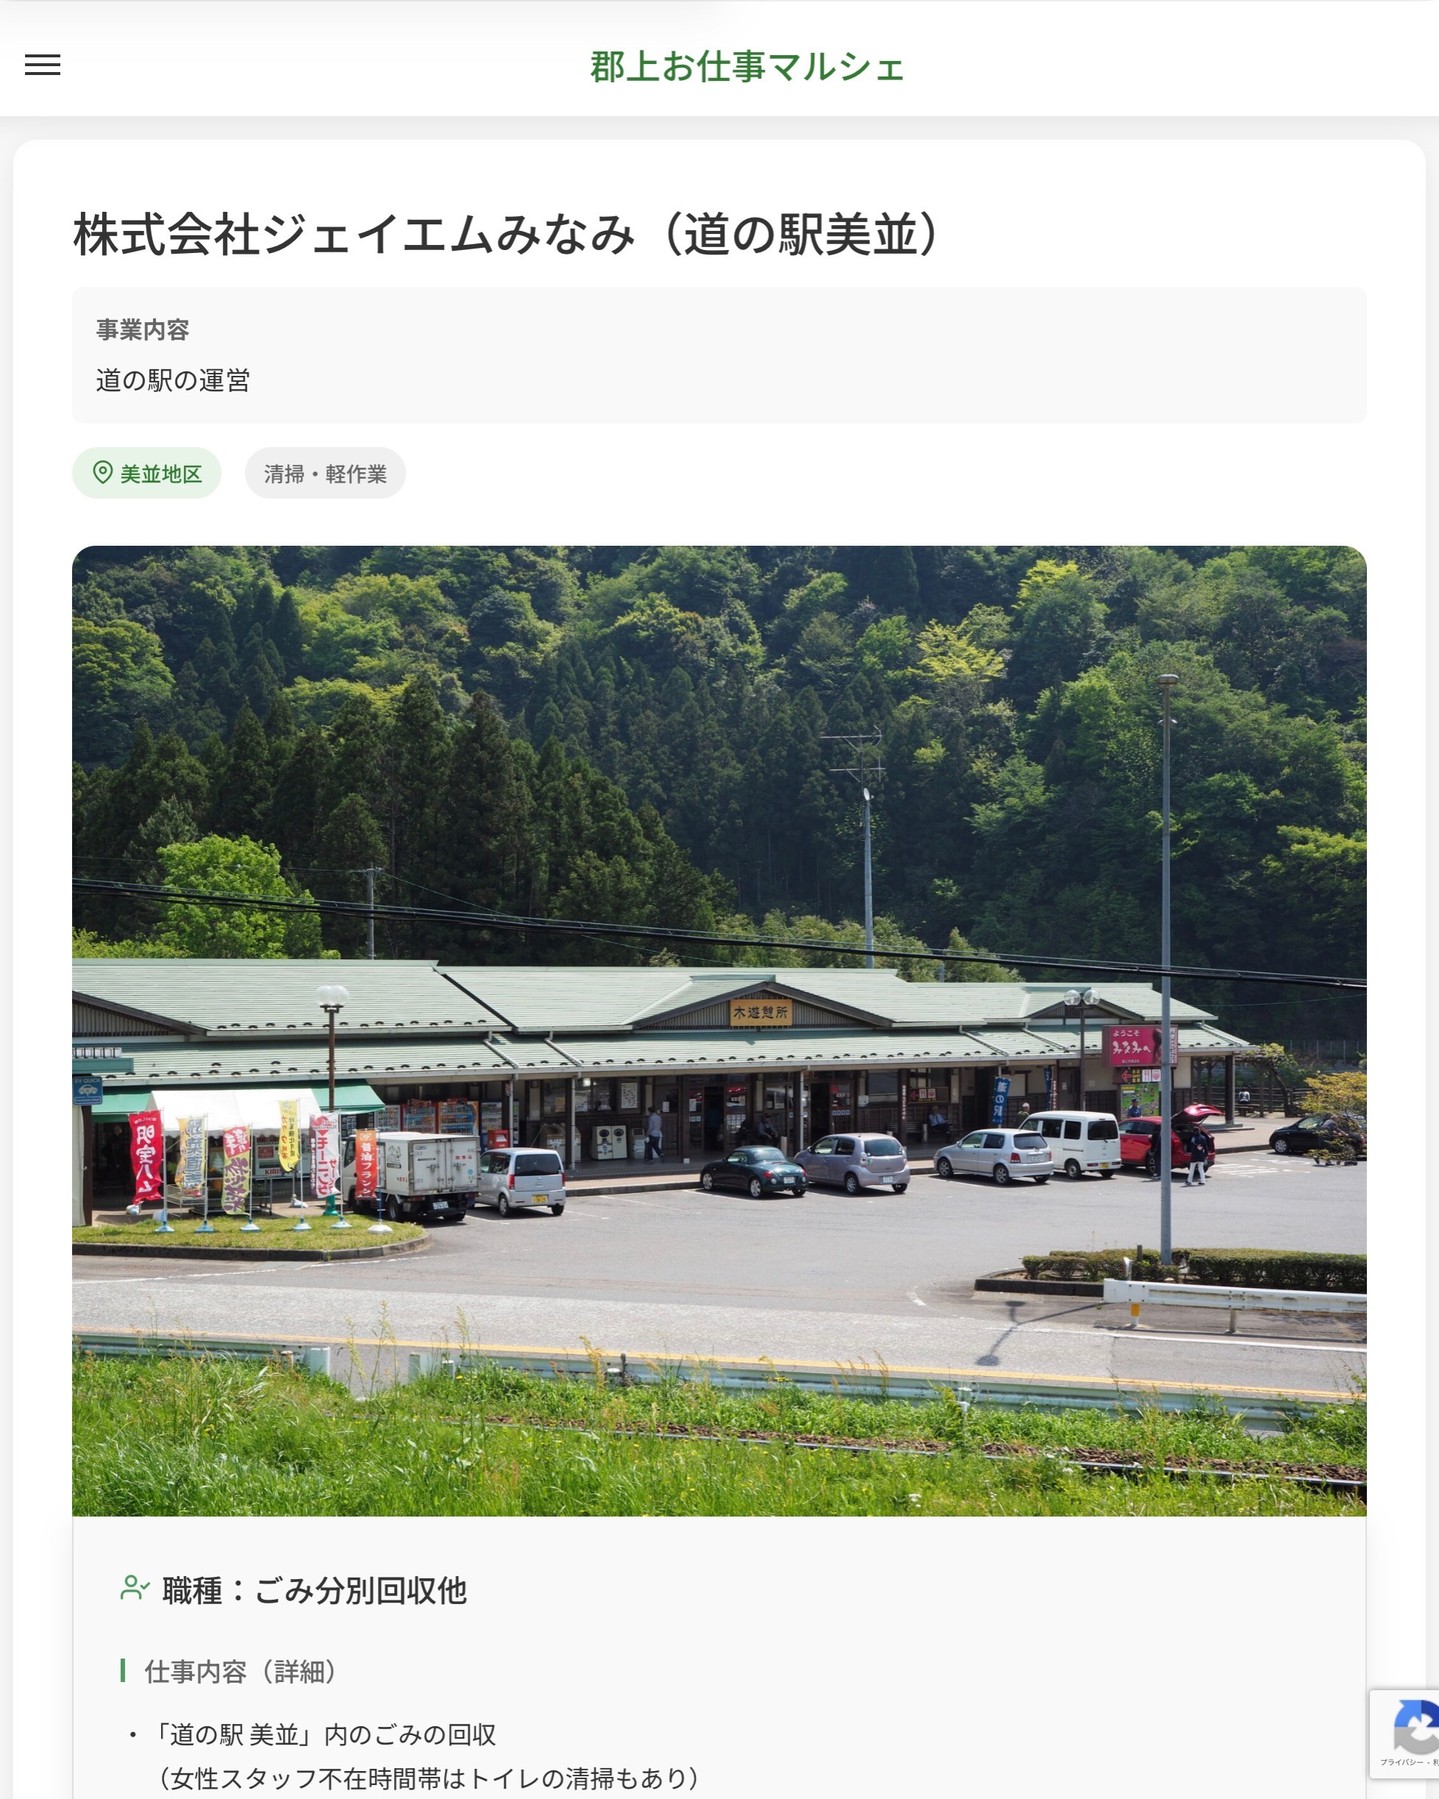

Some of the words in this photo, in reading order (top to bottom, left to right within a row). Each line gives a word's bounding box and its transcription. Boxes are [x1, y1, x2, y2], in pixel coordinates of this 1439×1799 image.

[590, 49, 904, 83] 郡上お仕事マルシェ
[73, 211, 935, 257] 株式会社ジェイエムみなみ（道の駅美並）
[96, 318, 190, 342] 事業内容
[96, 368, 250, 393] 道の駅の運営
[121, 464, 203, 485] 美並地区
[264, 464, 387, 485] 清掃・軽作業
[733, 1006, 788, 1019] 木遊憩所
[1113, 1029, 1140, 1037] ようこそ
[162, 1576, 468, 1606] 職種：ごみ分別回収他
[145, 1659, 336, 1685] 仕事内容（詳細）
[249, 1723, 497, 1747] 美並」内のごみの回収
[161, 1767, 698, 1791] （女性スタッフ不在時間帯はトイレの清掃もあり）
